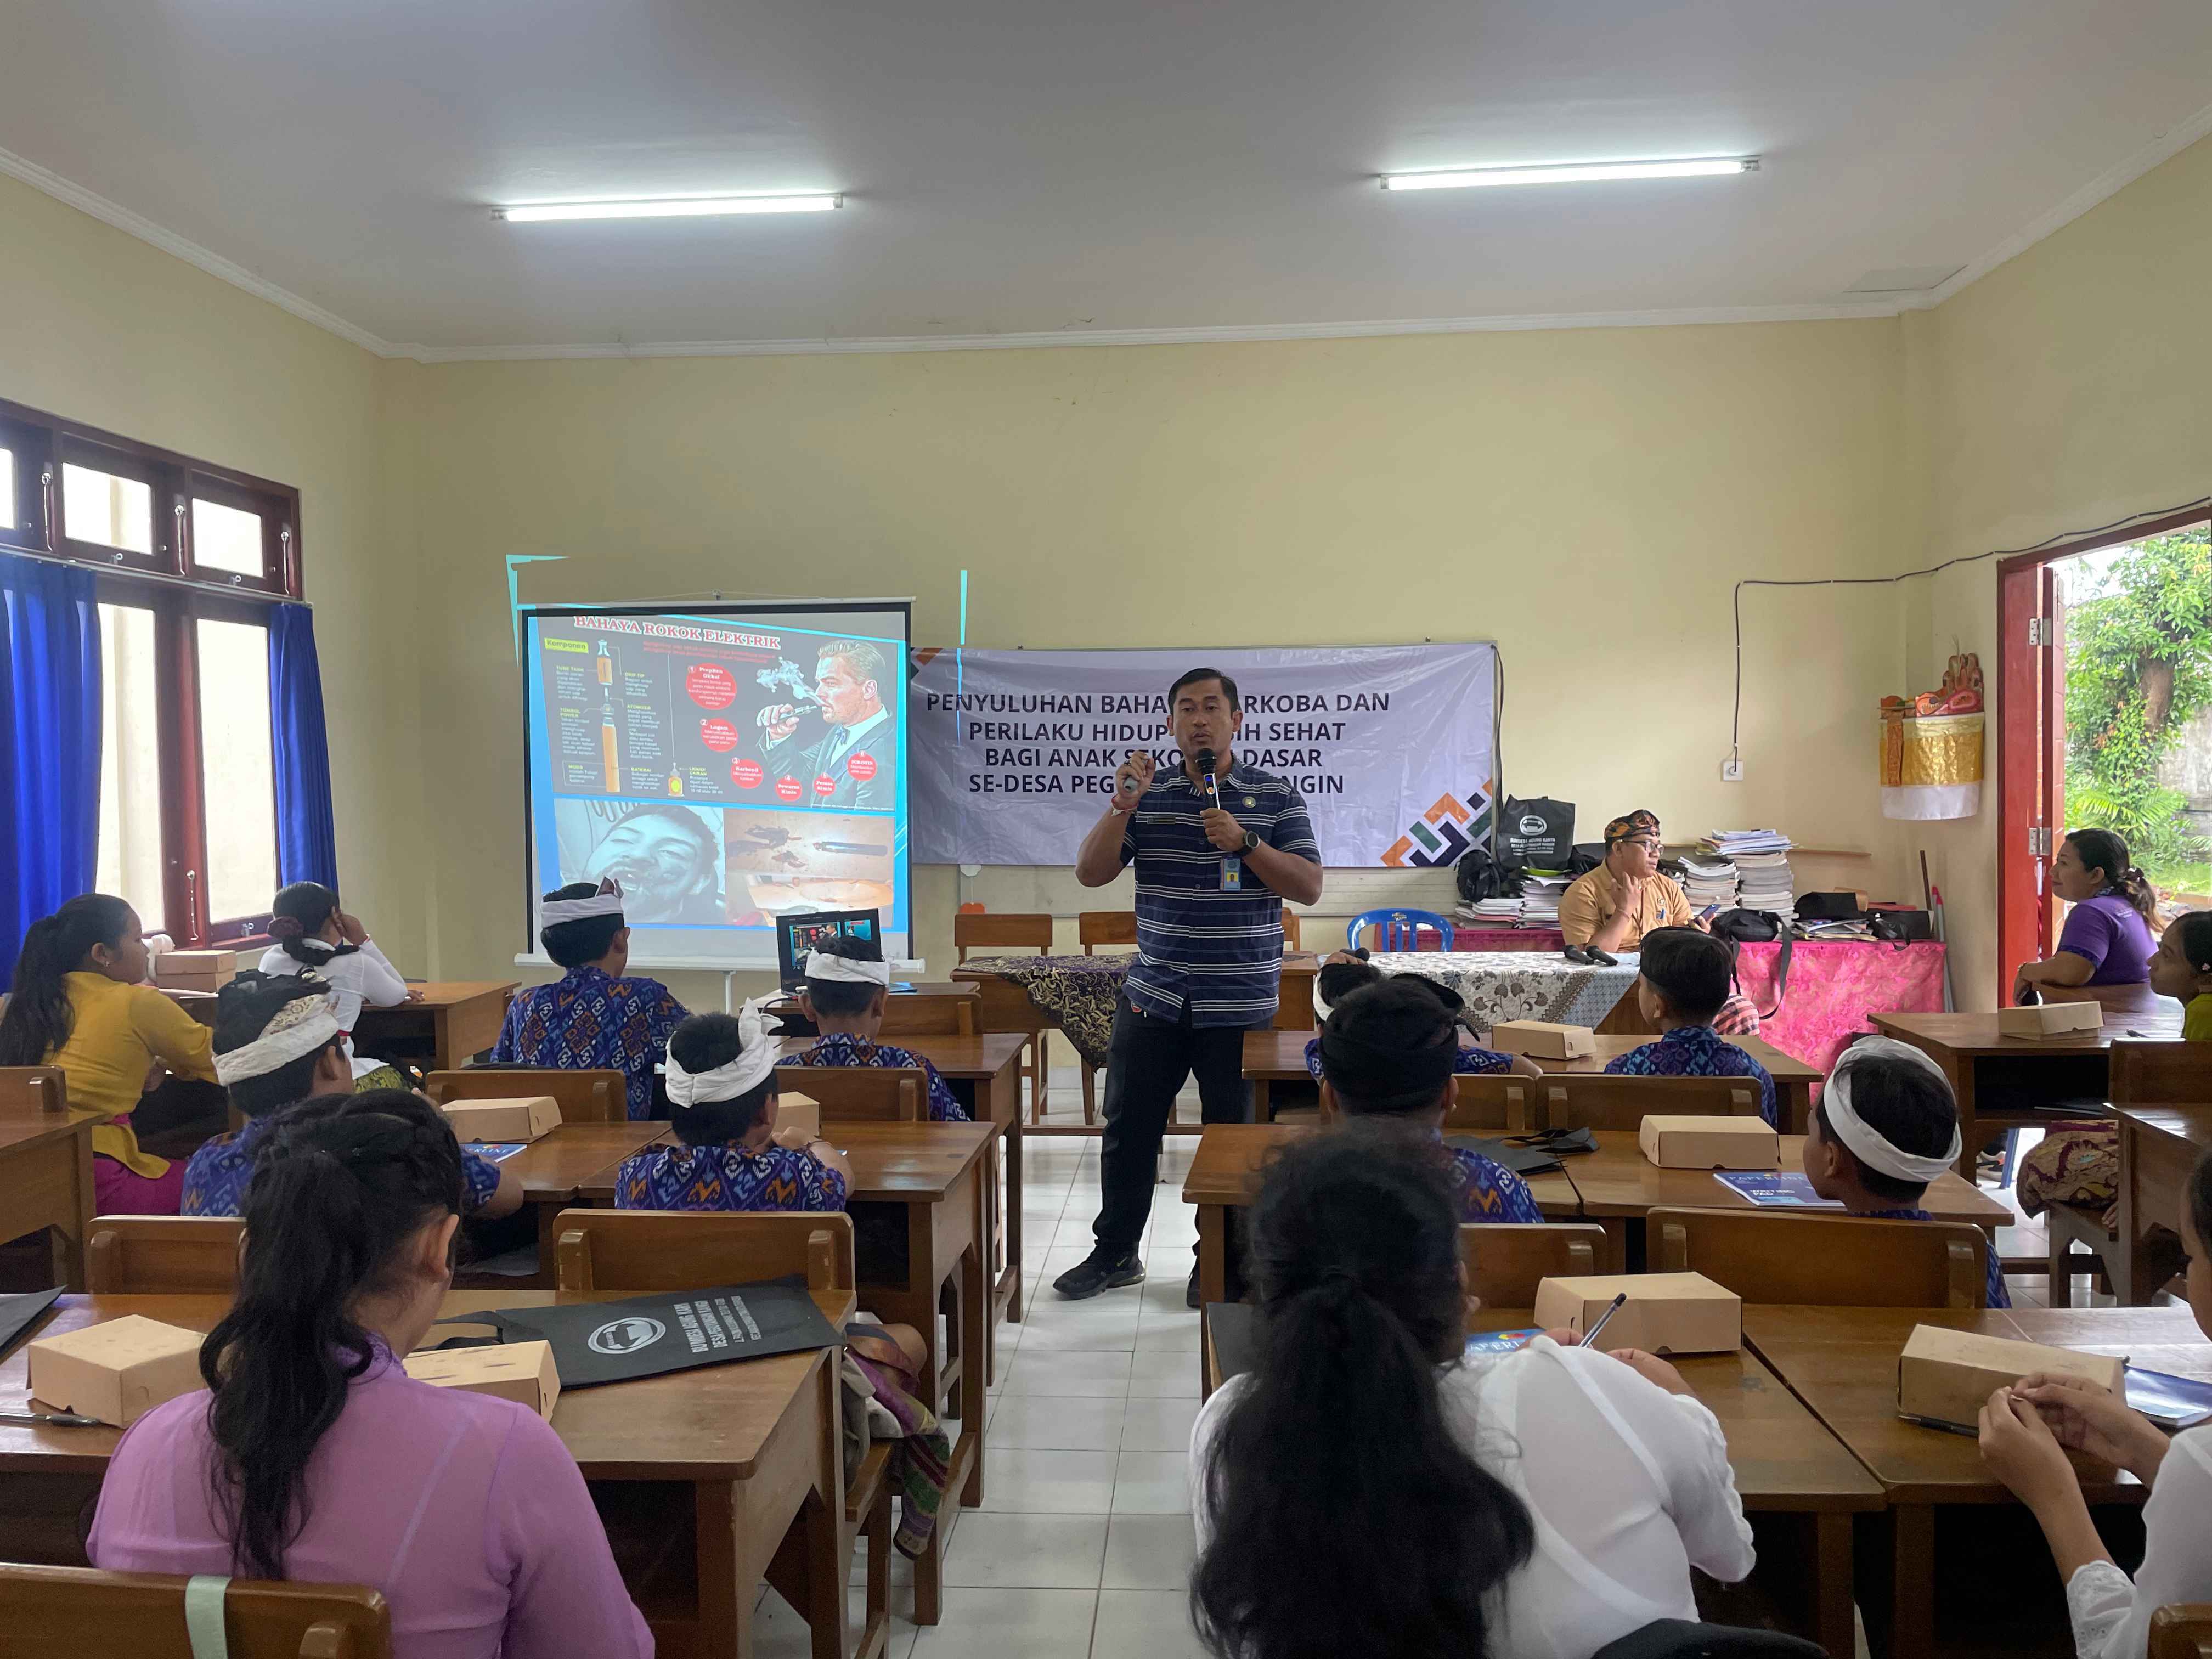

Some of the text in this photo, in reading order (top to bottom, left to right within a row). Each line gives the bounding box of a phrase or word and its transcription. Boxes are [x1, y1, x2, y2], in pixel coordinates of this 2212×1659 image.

[574, 616, 781, 650] BAHAYA ROKOK ELEKTRIK
[927, 693, 1091, 713] PENYULUHAN
[1338, 693, 1389, 712] DAN
[970, 722, 1083, 741] PERILAKU
[1093, 724, 1168, 741] HIDUP
[1269, 723, 1345, 741] SEHAT
[986, 749, 1040, 766] BAGI
[1048, 749, 1116, 767] ANAK
[1244, 749, 1322, 767] DASAR
[969, 775, 1063, 793] SE-DESA
